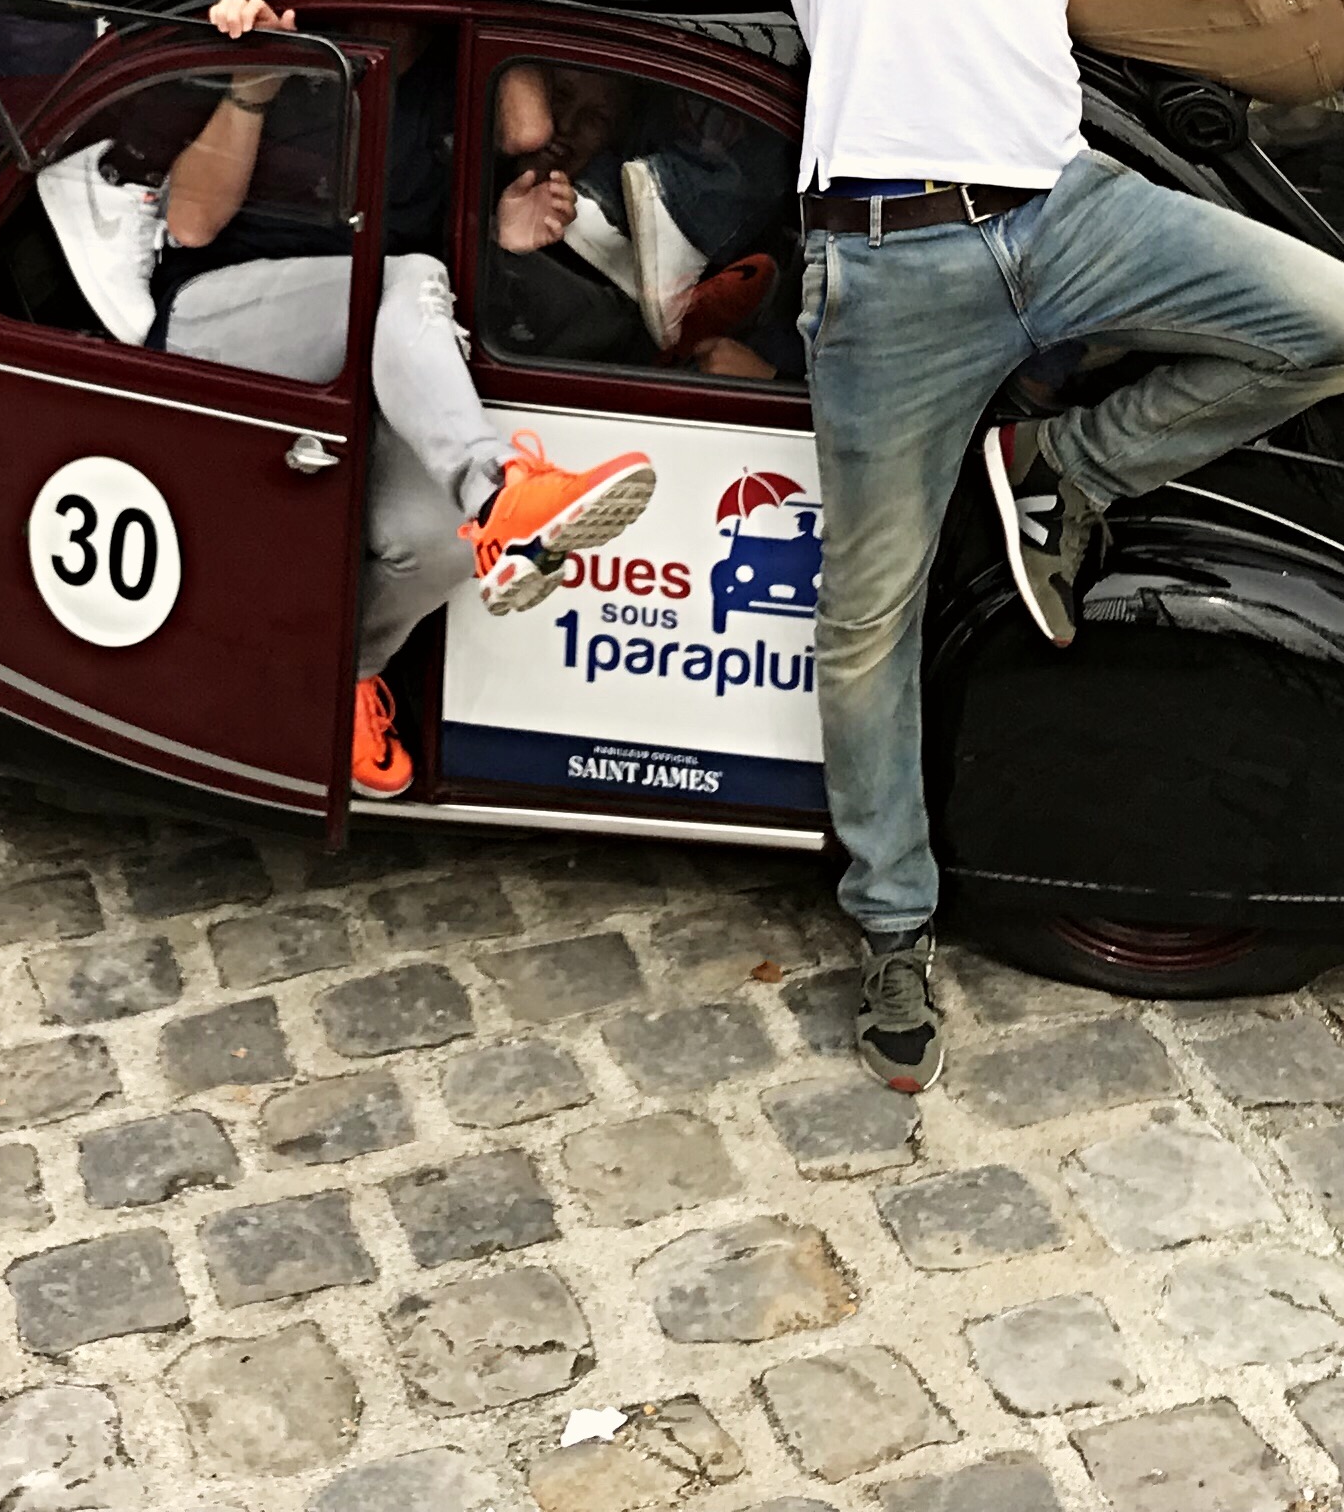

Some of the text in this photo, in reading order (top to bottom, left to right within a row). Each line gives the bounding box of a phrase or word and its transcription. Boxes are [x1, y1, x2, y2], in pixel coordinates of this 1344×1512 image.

[51, 494, 158, 601] 30
[560, 551, 692, 599] oues
[601, 603, 678, 629] sous
[555, 608, 815, 697] 1paraplui
[567, 755, 720, 793] SAINT JAMES
